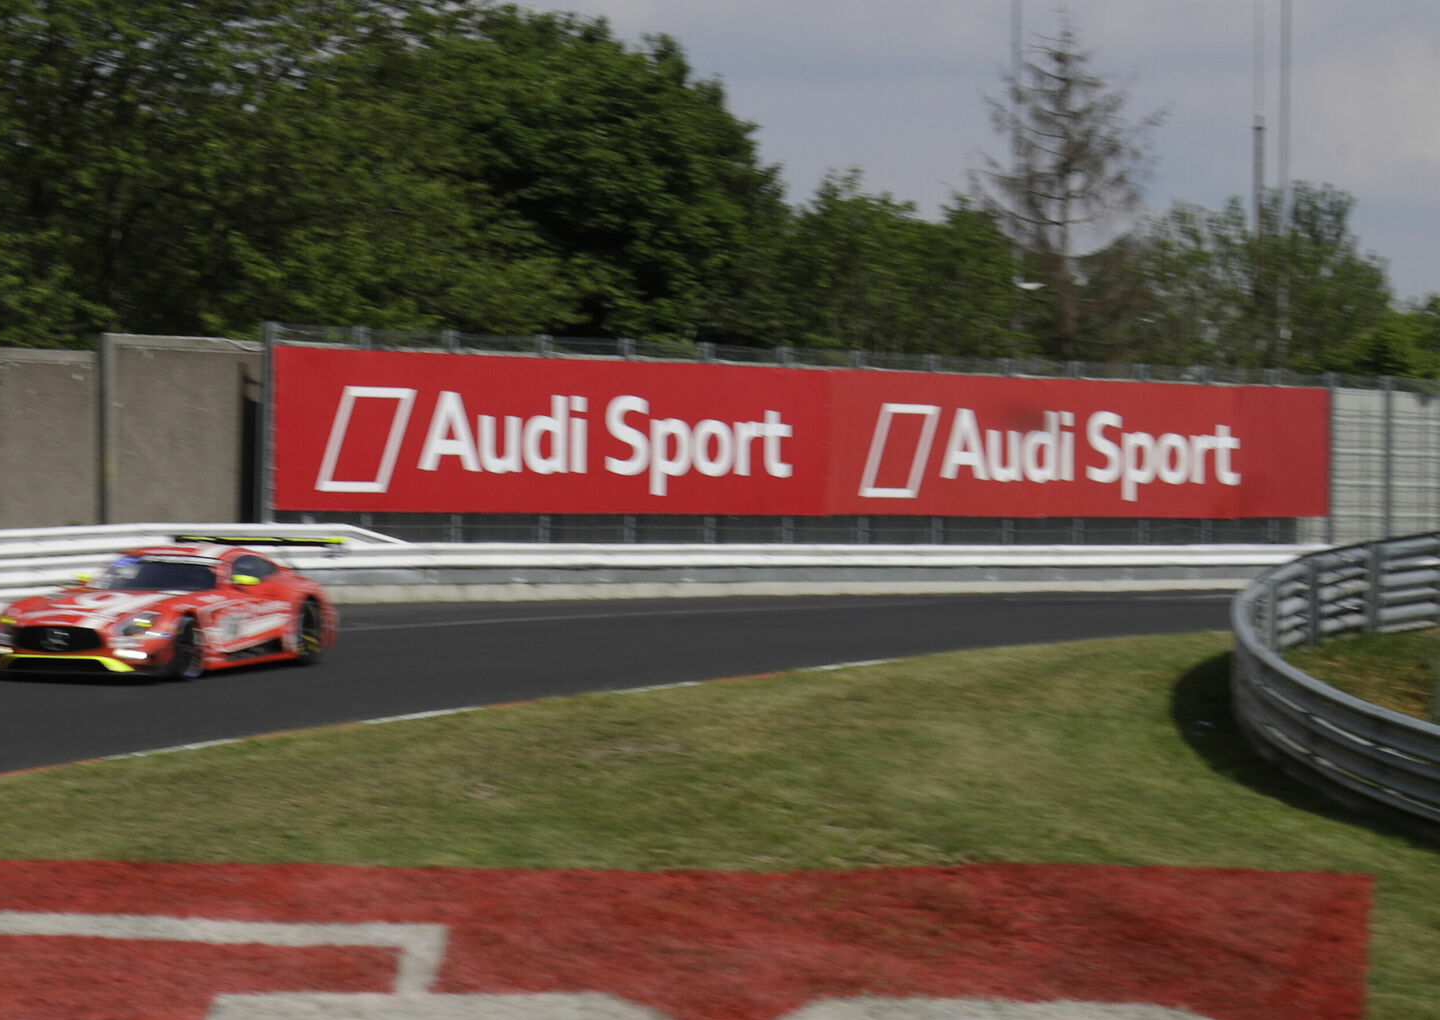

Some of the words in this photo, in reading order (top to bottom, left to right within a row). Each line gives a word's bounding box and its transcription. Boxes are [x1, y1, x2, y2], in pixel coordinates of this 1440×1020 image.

[417, 390, 588, 475] Audi
[604, 395, 793, 497] Sport
[940, 405, 1075, 482] Audi
[1086, 410, 1241, 501] Sport
